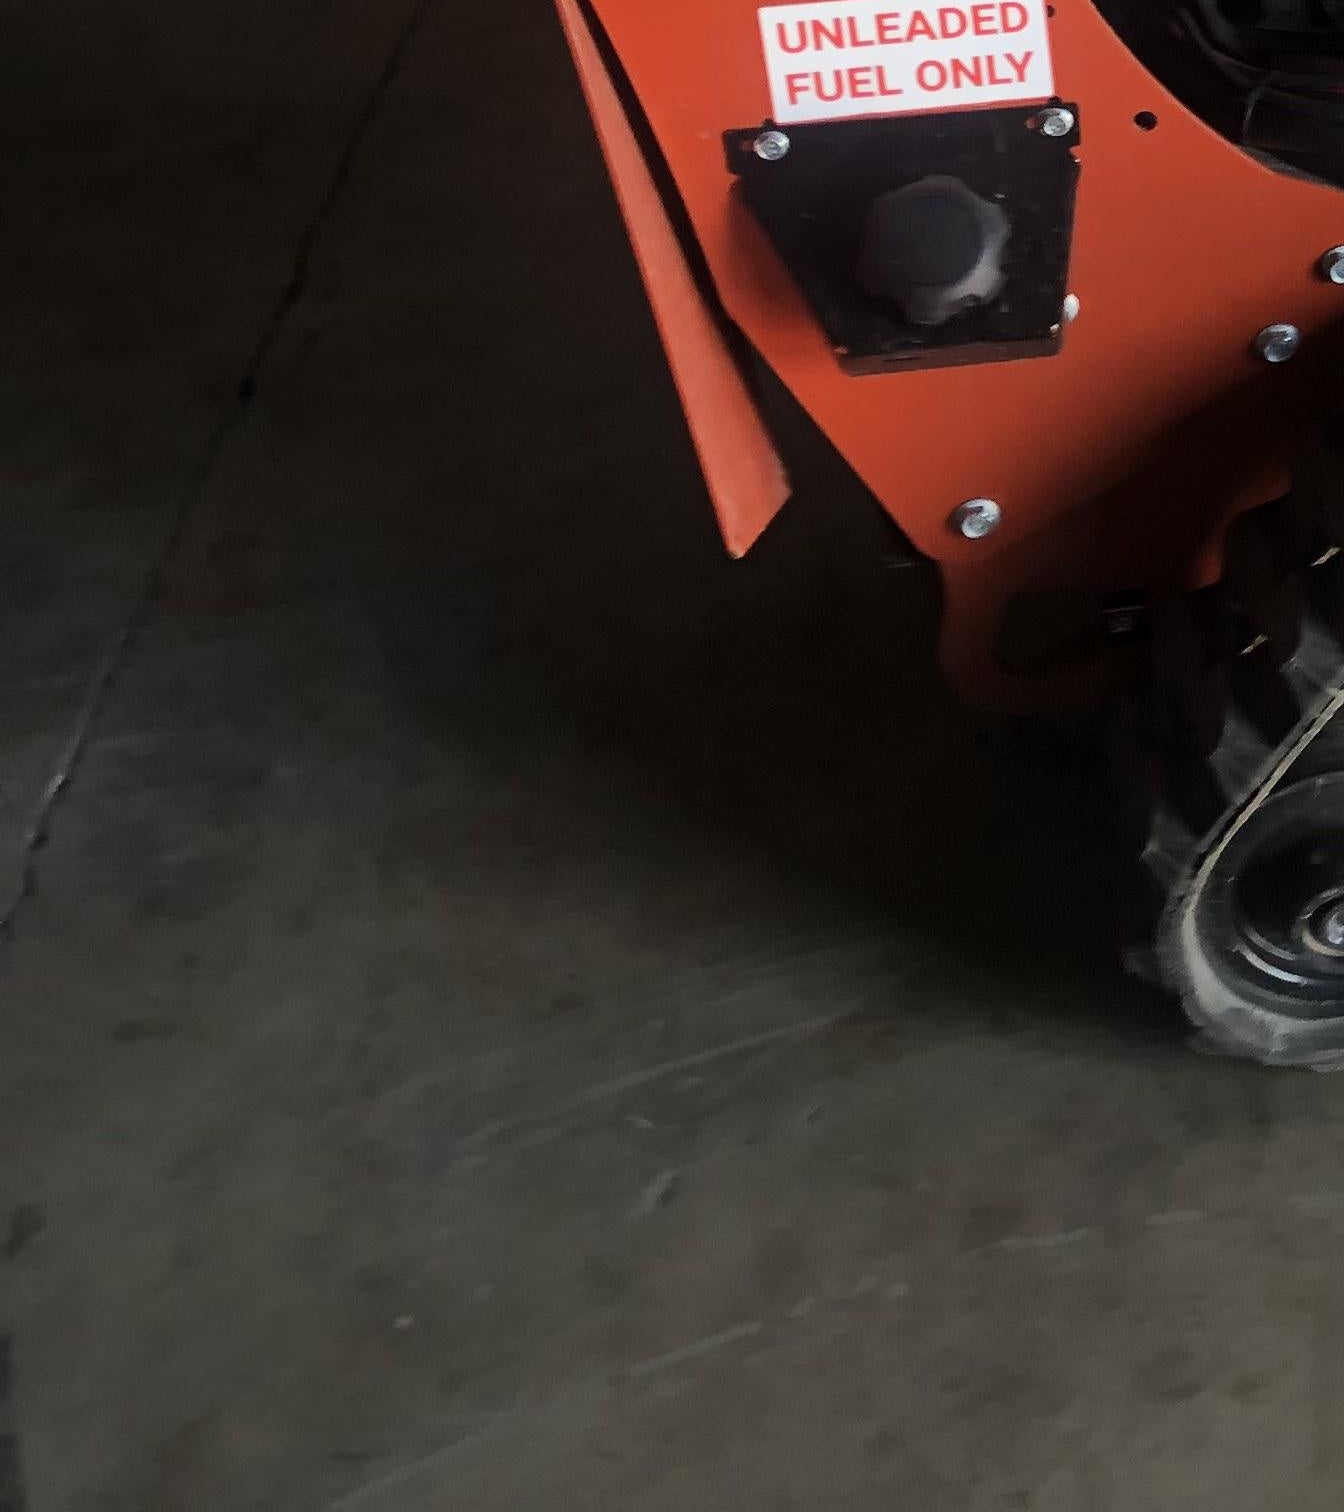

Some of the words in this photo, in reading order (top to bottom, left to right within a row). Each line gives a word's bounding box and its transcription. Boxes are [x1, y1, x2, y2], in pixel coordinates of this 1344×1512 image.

[775, 1, 1029, 54] UNLEADED
[784, 65, 904, 105] FUEL
[915, 50, 1034, 92] ONLY
